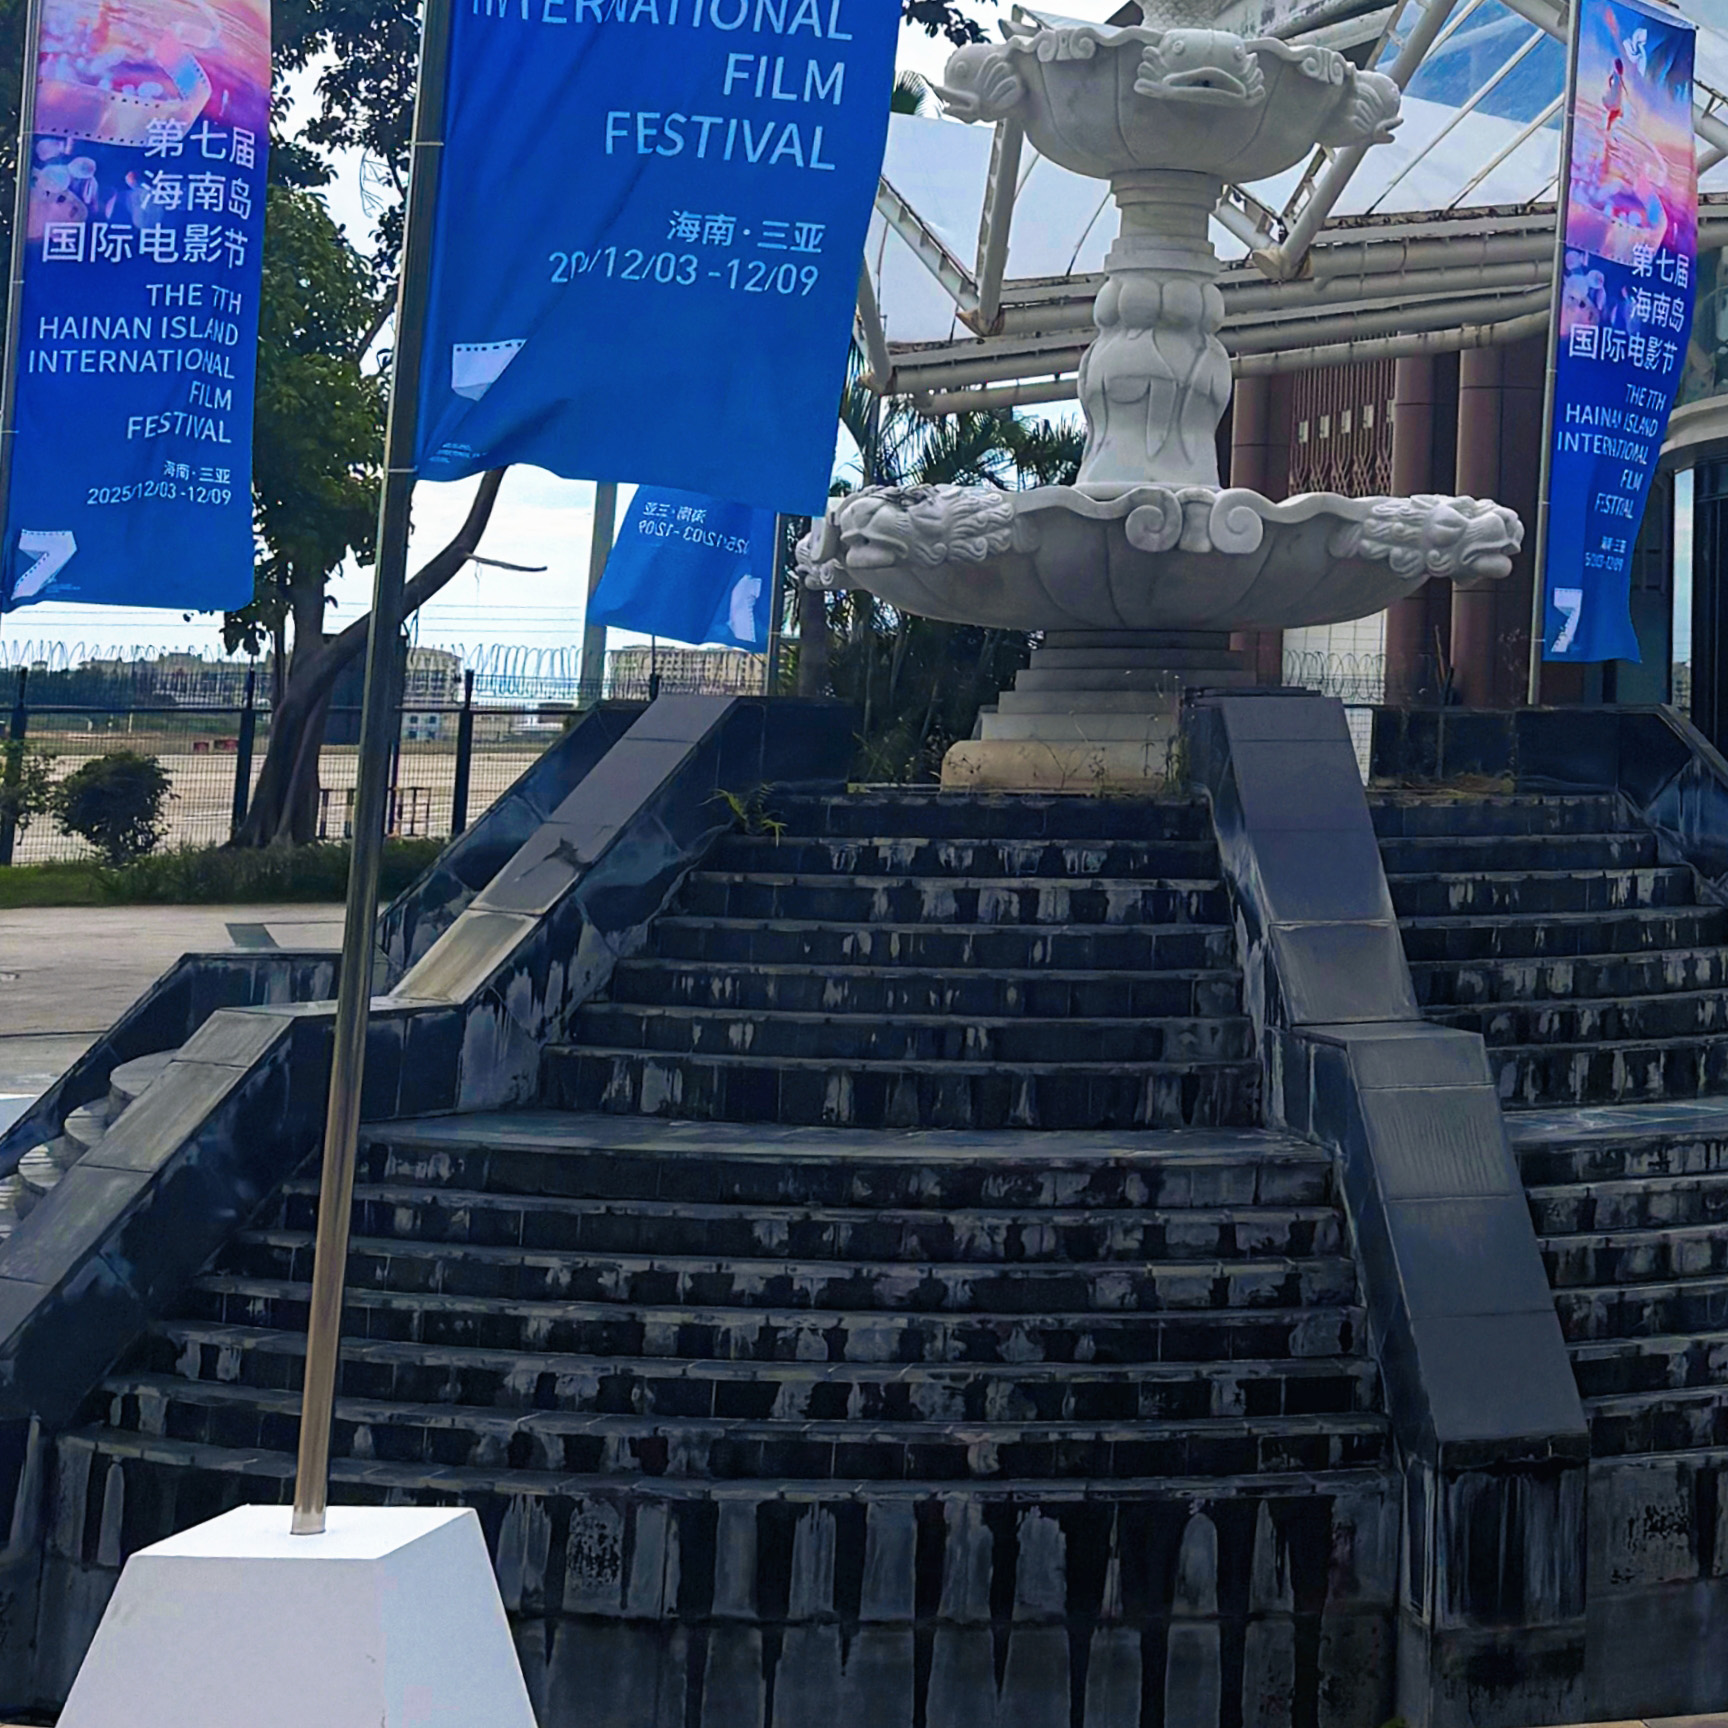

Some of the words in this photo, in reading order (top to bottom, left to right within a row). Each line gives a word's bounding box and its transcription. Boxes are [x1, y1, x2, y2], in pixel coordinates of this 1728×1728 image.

[723, 52, 845, 105] FILM
[144, 117, 255, 169] 第七届
[605, 110, 836, 171] FESTIVAL
[140, 170, 251, 220] 海南岛
[42, 221, 248, 269] 国际电影节
[1631, 243, 1690, 290] 第七届
[146, 283, 203, 306] THE
[1630, 286, 1685, 333] 海南岛
[39, 316, 151, 339] HAINAN
[161, 316, 238, 346] ISLAND
[1569, 323, 1678, 375] 国际电影节
[28, 348, 235, 379] INTERNATIONAL
[189, 380, 232, 411] FILM
[127, 411, 232, 443] FESTIVAL
[87, 480, 176, 505] 2025/12/03
